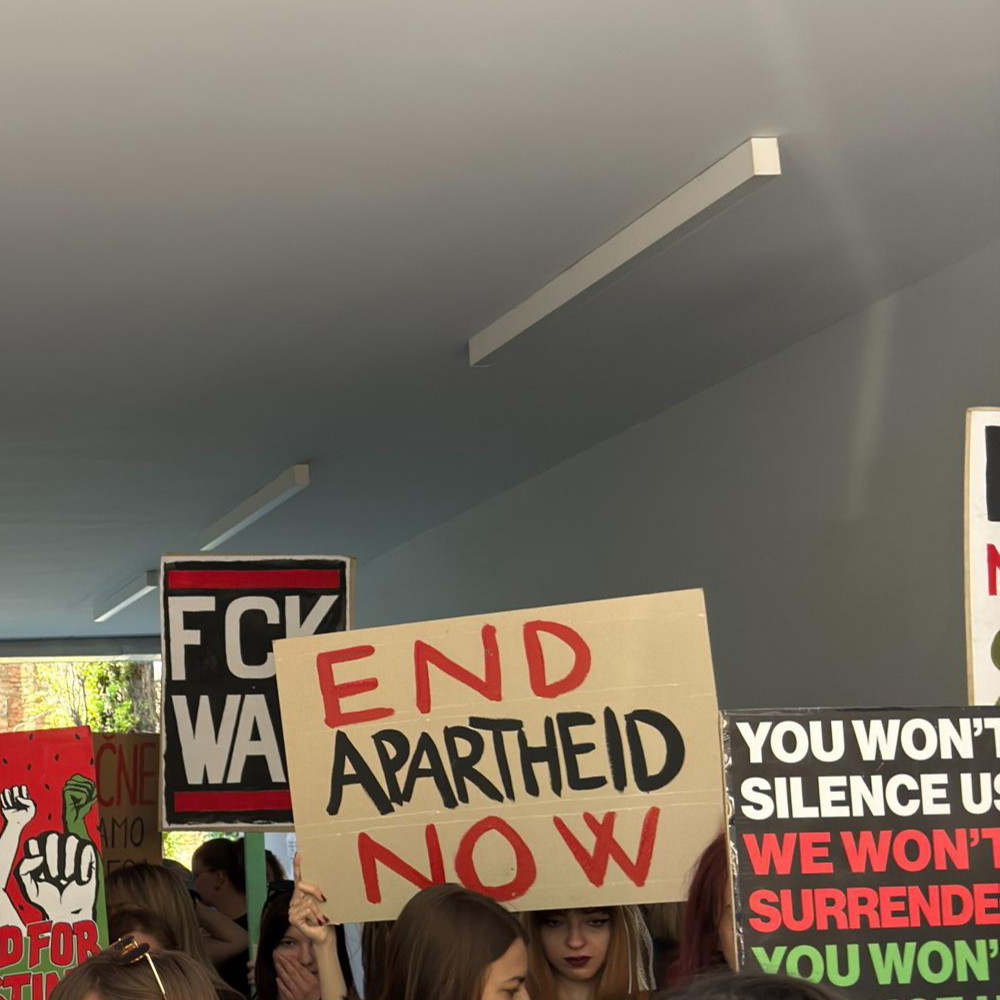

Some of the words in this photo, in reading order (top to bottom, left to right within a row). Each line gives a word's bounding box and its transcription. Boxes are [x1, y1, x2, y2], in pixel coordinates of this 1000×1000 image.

[316, 620, 592, 728] END
[326, 706, 686, 816] APARTHEID
[736, 719, 845, 764] YOU
[740, 774, 951, 820] SILENCE
[960, 772, 1000, 815] U
[357, 806, 660, 903] NOW
[742, 832, 834, 875] WE
[748, 884, 1000, 933] SURRENDE
[26, 919, 104, 969] FOR
[751, 943, 861, 988] YOU
